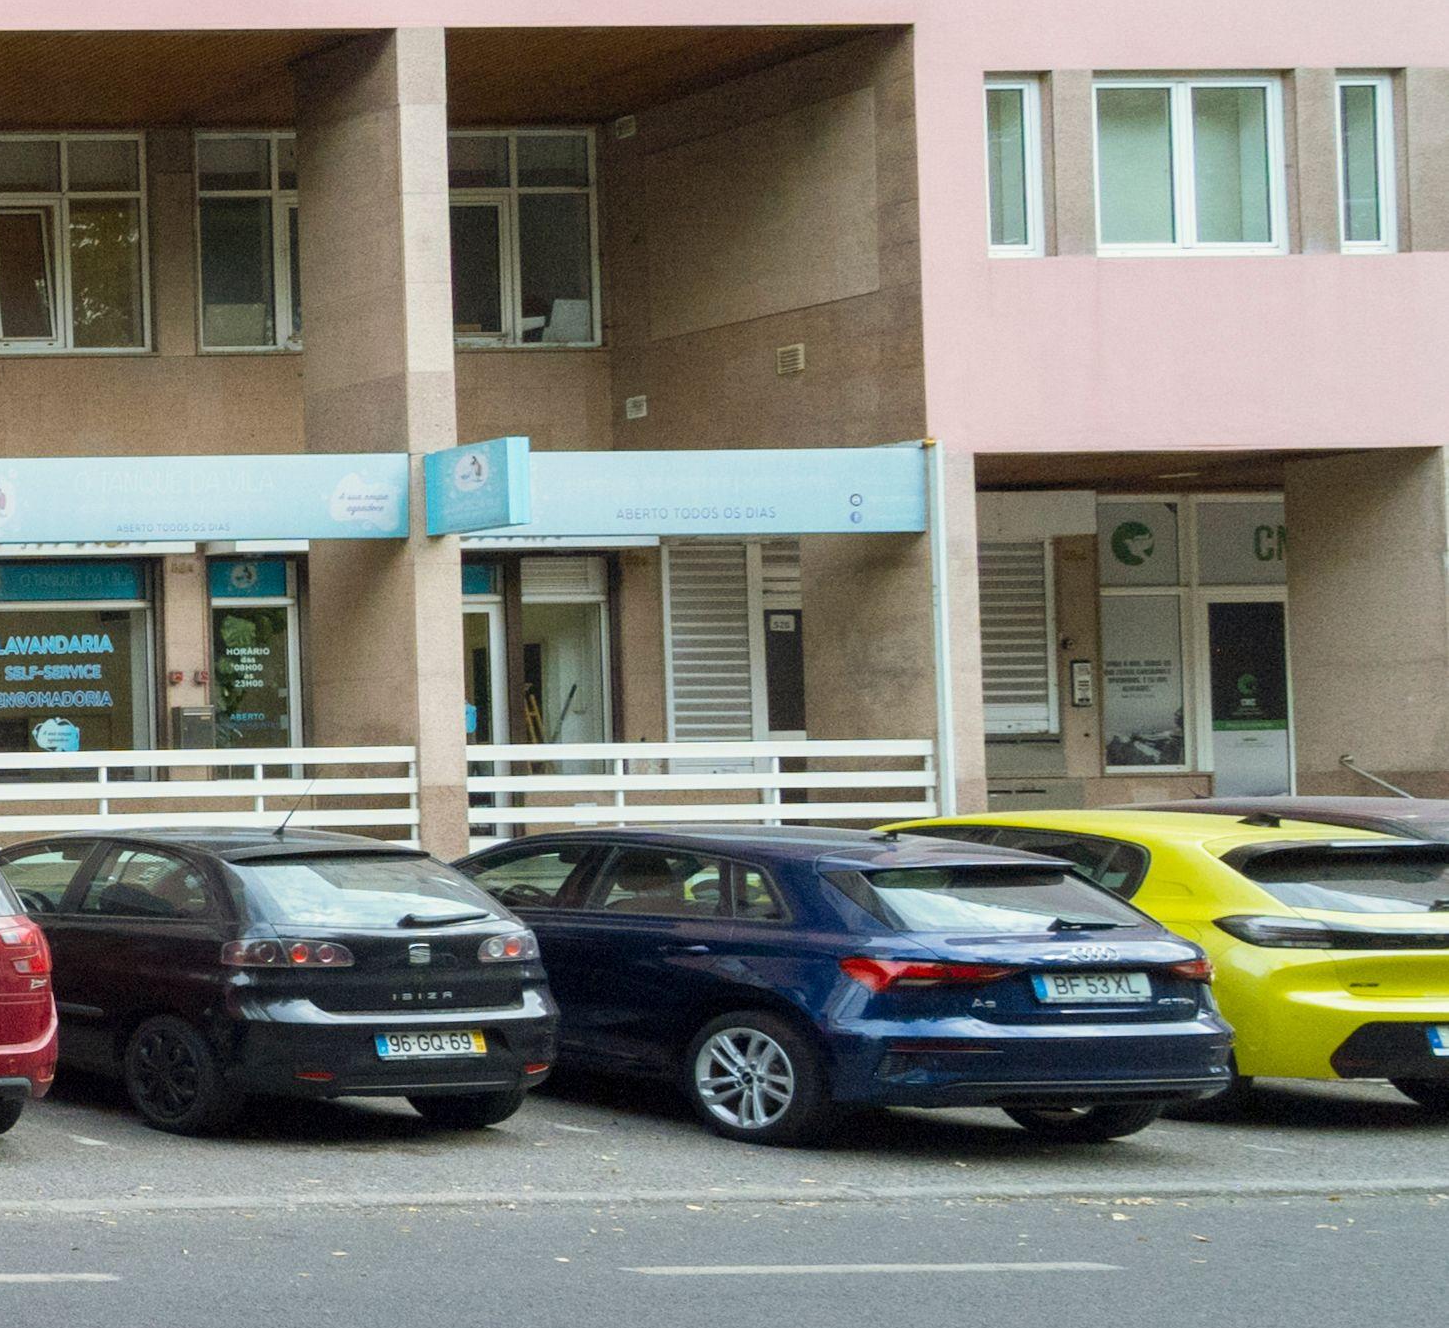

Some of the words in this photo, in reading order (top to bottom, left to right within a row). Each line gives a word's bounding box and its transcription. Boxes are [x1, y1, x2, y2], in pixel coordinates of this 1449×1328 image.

[616, 508, 668, 520] ABERTO
[674, 507, 719, 519] TODOS
[723, 507, 741, 519] OS
[746, 506, 777, 518] DIAS
[116, 524, 154, 533] ABERTO
[158, 524, 190, 532] TODOS
[192, 524, 206, 532] OS
[209, 523, 231, 532] DIAS
[226, 647, 270, 656] HORÁRIO
[4, 664, 102, 681] SELF-SERVICE
[229, 712, 265, 721] ABERTO
[393, 991, 453, 1001] IBIZA
